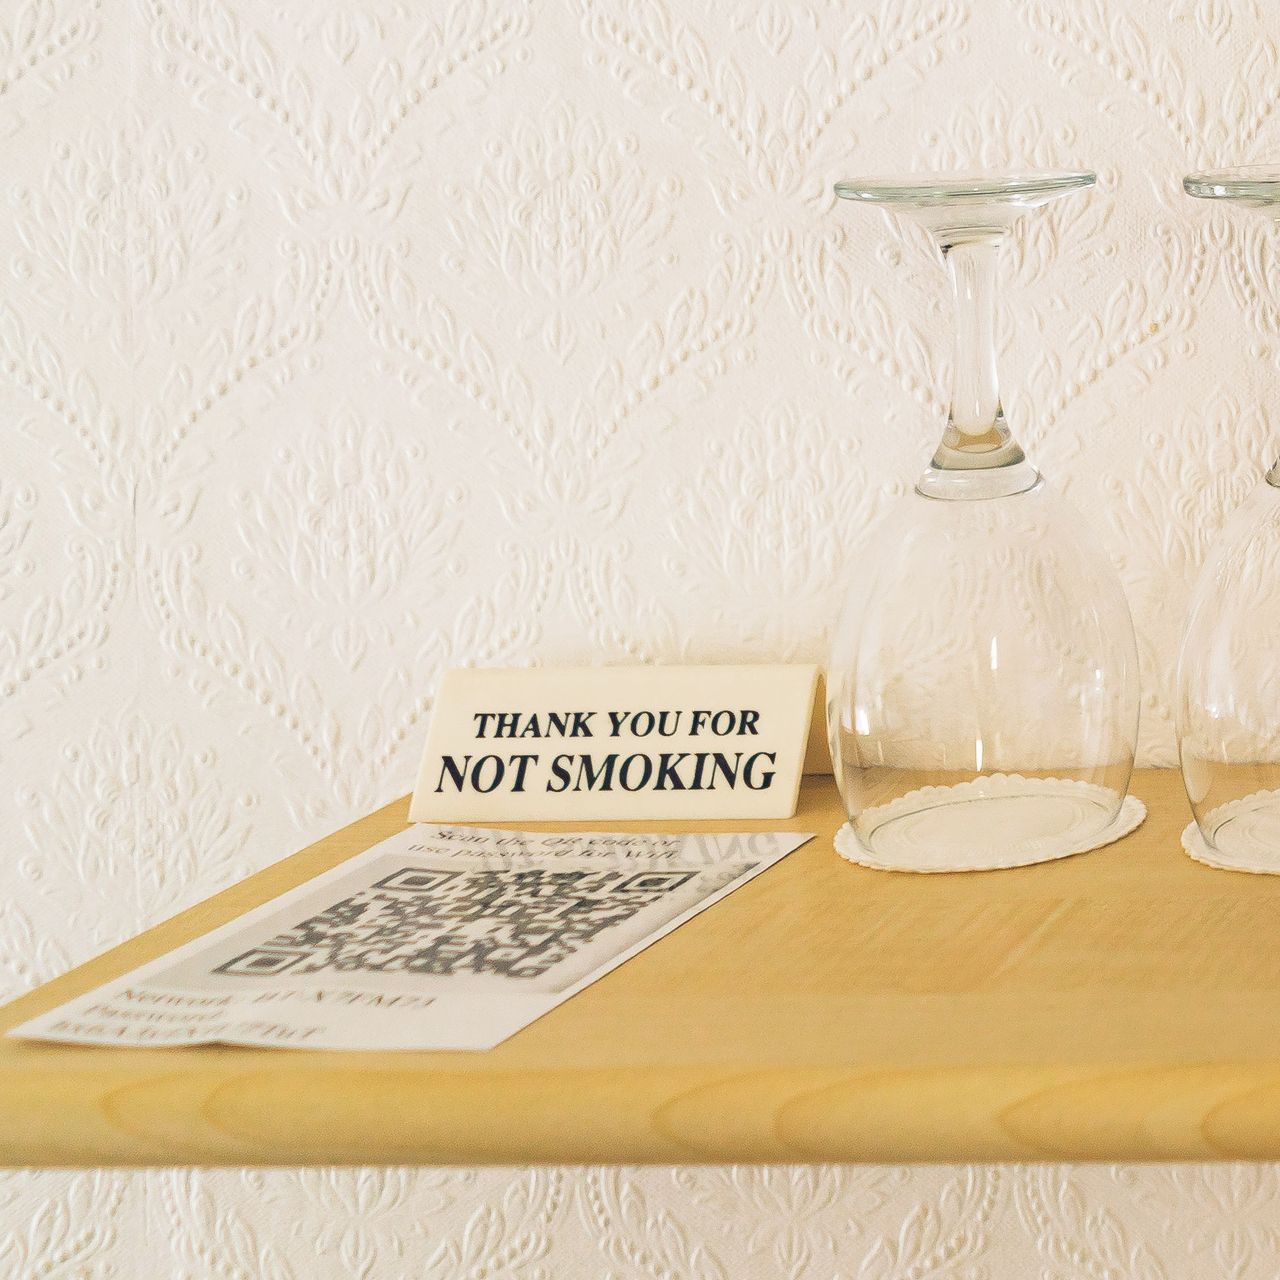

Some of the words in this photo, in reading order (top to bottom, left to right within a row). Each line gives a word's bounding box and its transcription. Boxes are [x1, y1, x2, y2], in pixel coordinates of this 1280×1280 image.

[474, 711, 597, 738] THANK
[608, 711, 683, 737] YOU
[688, 710, 760, 736] FOR
[434, 755, 539, 793] NOT
[546, 751, 777, 792] SMOKING
[431, 830, 490, 846] Scan
[496, 833, 532, 847] the
[540, 837, 583, 848] QR
[588, 837, 648, 848] code
[451, 846, 573, 858] password
